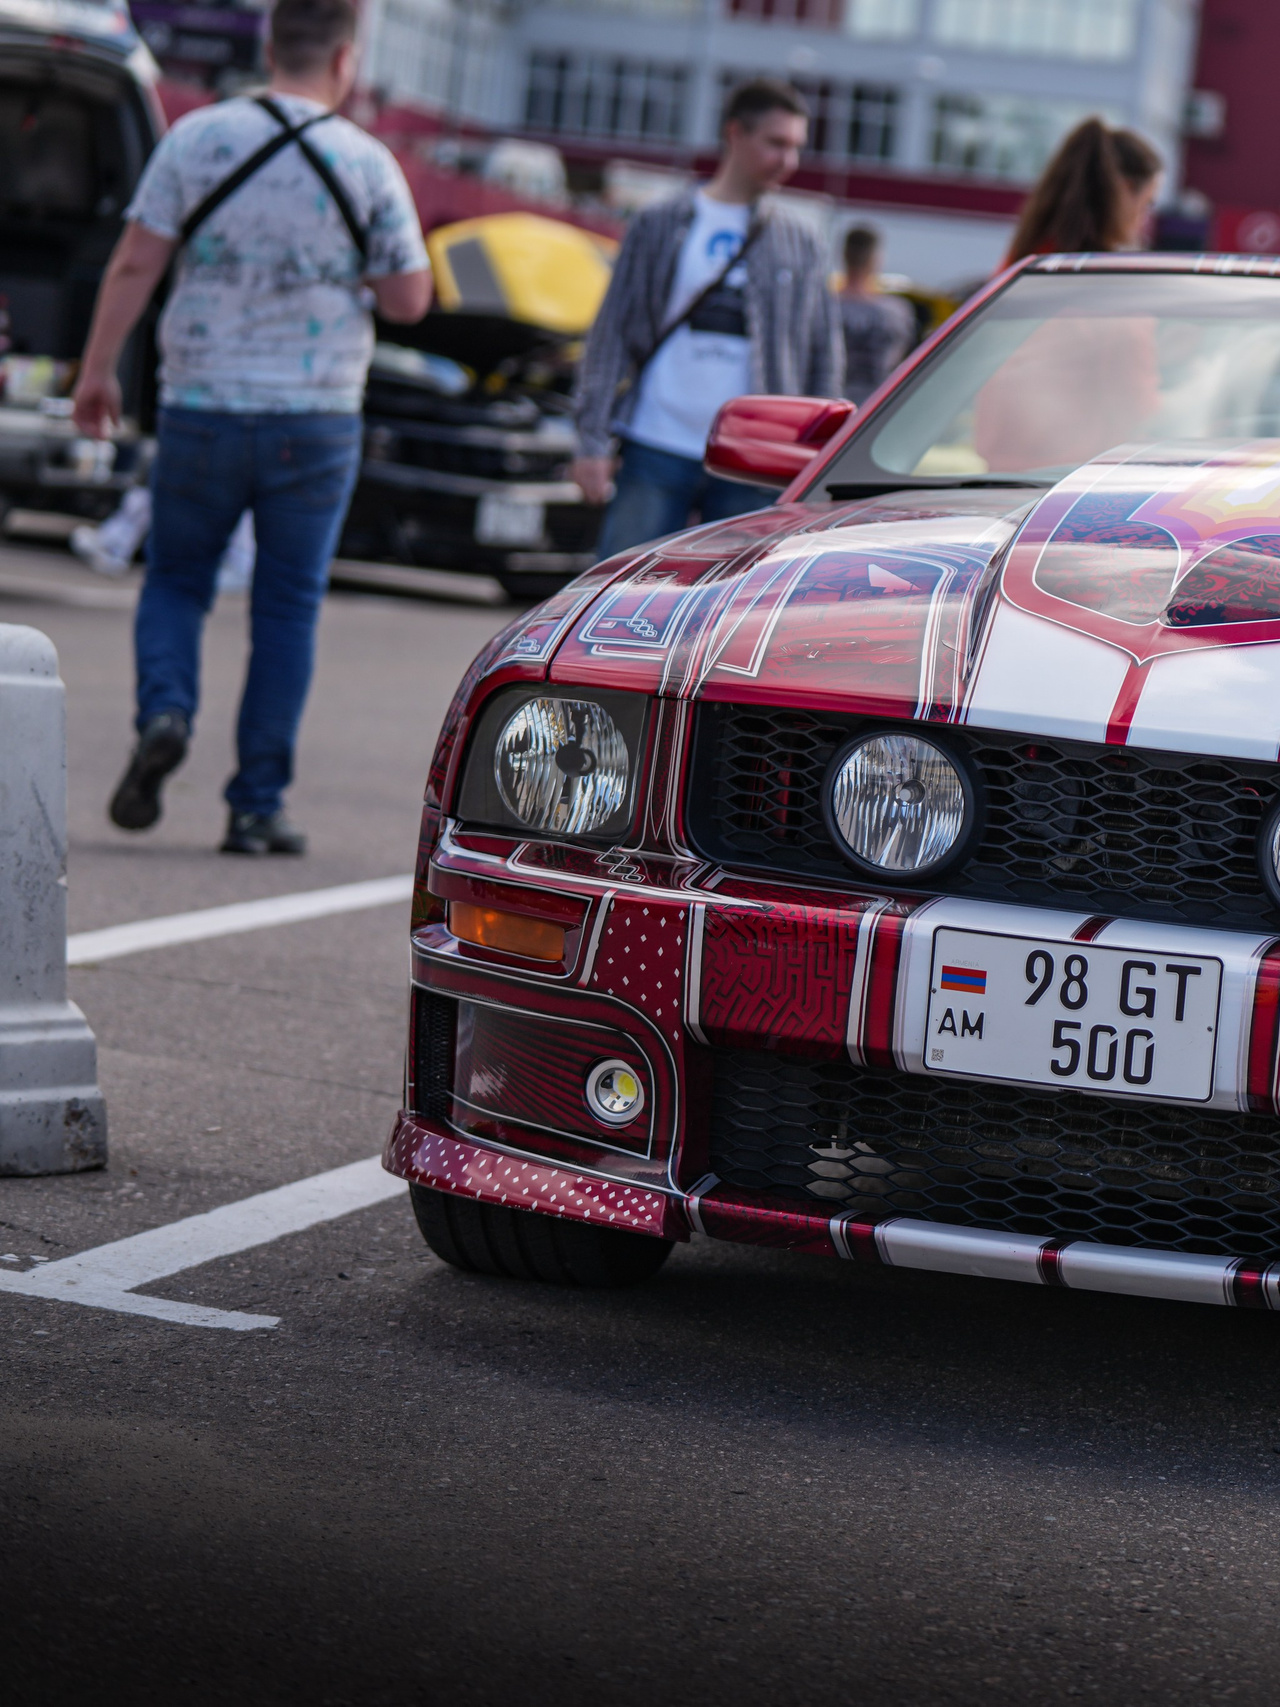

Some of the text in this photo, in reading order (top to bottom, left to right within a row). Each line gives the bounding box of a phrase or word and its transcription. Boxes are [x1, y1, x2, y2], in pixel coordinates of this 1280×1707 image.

[951, 959, 980, 968] ARMENIA
[1024, 949, 1202, 1021] 98 GT
[937, 1007, 985, 1039] AM
[1050, 1019, 1155, 1085] 500
